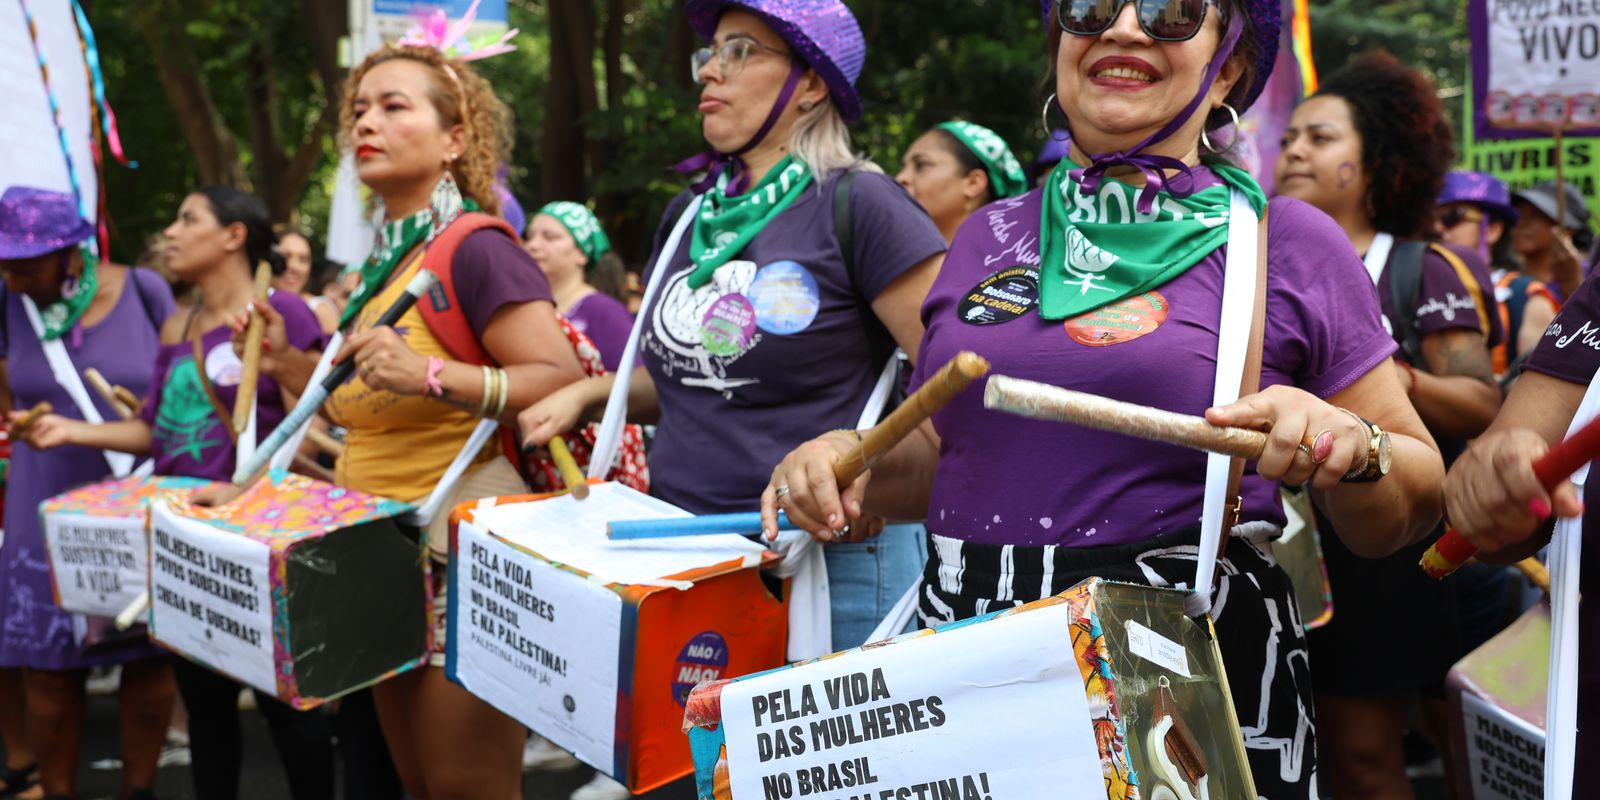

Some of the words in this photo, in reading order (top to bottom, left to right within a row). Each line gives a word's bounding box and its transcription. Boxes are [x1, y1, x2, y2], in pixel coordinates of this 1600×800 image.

[968, 293, 985, 302] na
[983, 298, 1028, 314] cadeia!
[982, 285, 1032, 306] Bolsonaro
[155, 527, 206, 567] MULHERES
[155, 551, 185, 581] POVOS
[472, 541, 499, 574] PELA
[503, 558, 533, 590] VIDA
[471, 588, 484, 608] NO
[486, 597, 521, 630] BRASIL
[472, 563, 492, 589] DAS
[494, 576, 555, 623] MULHERES
[189, 600, 204, 622] DE
[205, 607, 262, 649] GUERRAS!
[471, 608, 478, 626] E
[480, 612, 495, 636] NA
[498, 623, 567, 678] PALESTINA!
[471, 631, 513, 664] PALESTINA
[687, 643, 714, 660] NÃO
[677, 664, 720, 685] NÃO!
[752, 684, 819, 727] PELA
[824, 668, 890, 710] VIDA
[757, 725, 806, 762] DAS
[810, 696, 946, 751] MULHERES
[762, 773, 793, 800] NO
[796, 757, 878, 796] BRASIL
[835, 772, 993, 800] TINA!
